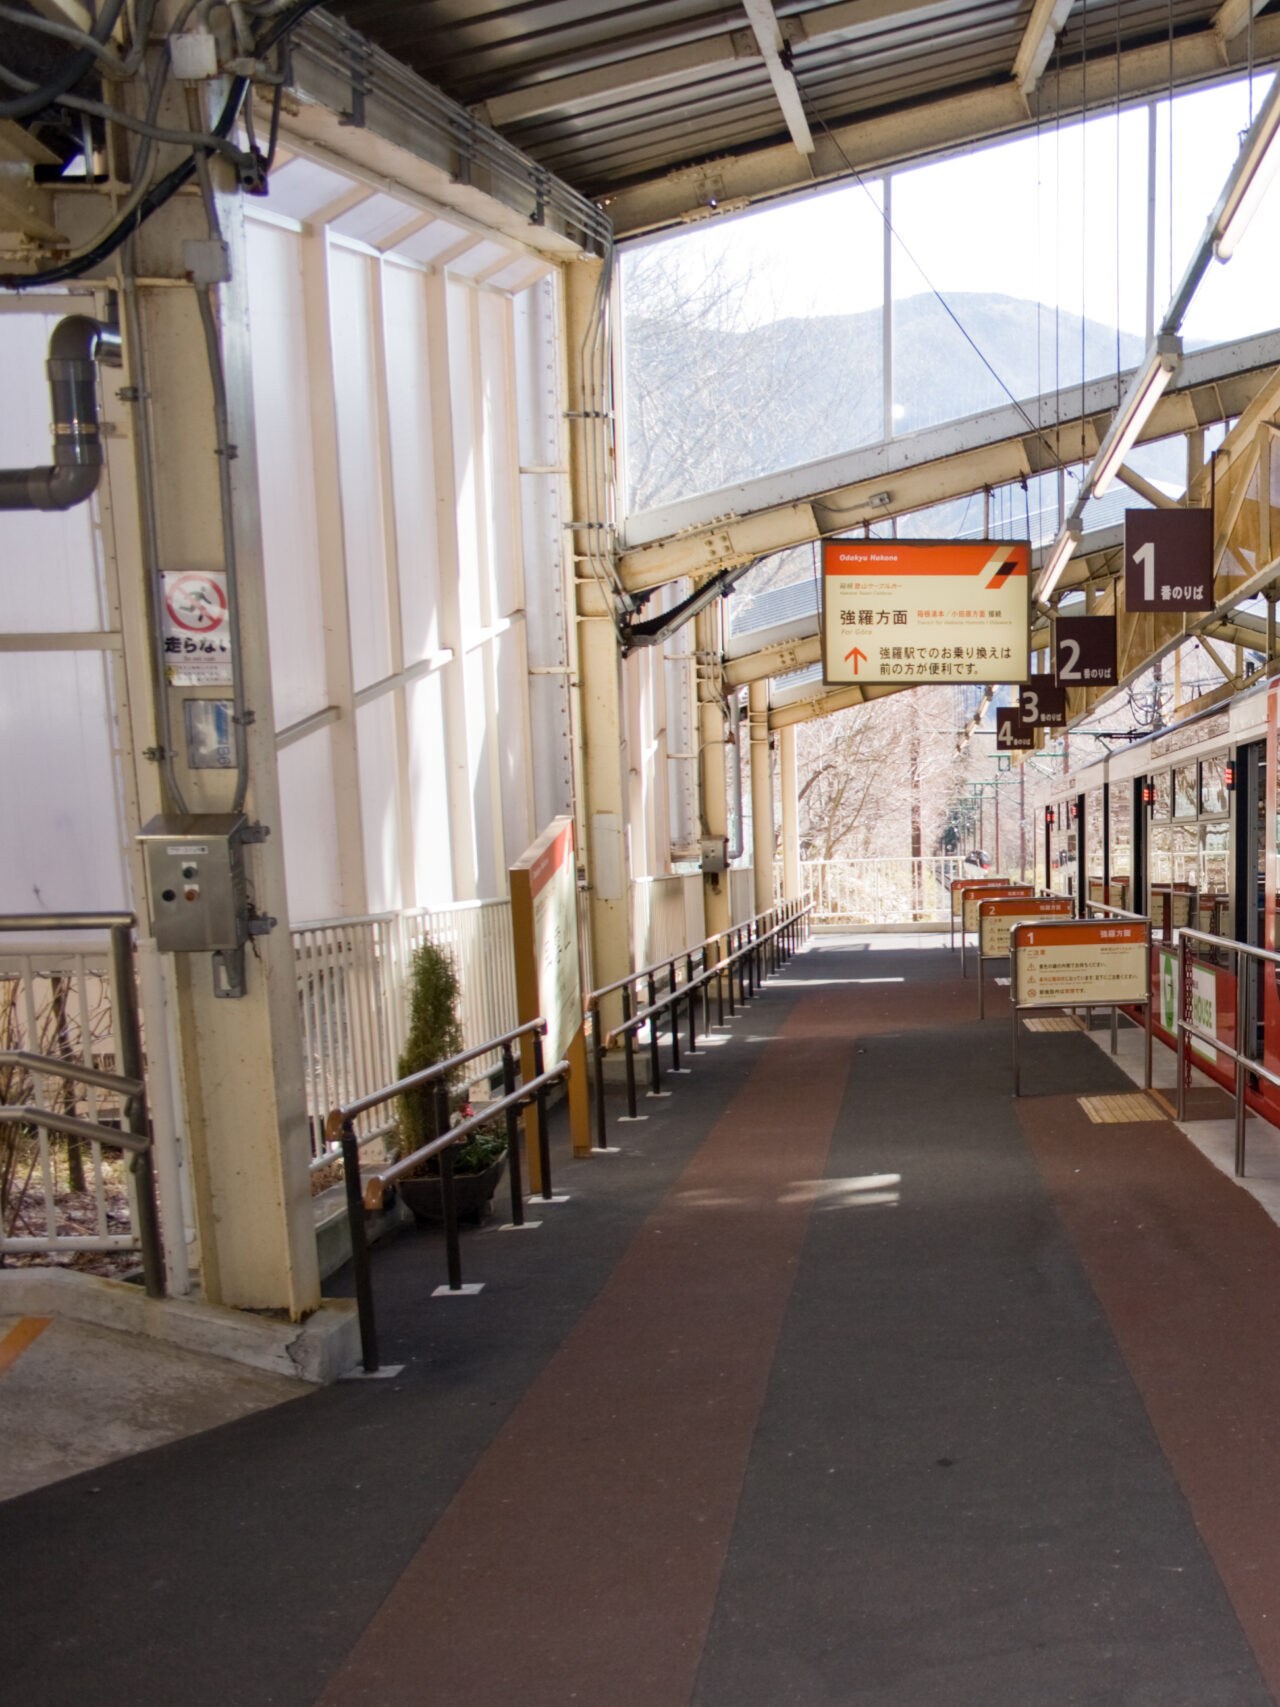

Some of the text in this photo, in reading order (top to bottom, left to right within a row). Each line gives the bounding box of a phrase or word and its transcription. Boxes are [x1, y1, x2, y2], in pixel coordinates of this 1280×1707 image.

[840, 554, 867, 562] Odakyu
[840, 610, 908, 625] 強羅方面
[880, 647, 1011, 660] 強羅駅でのお乗り換えは
[880, 663, 978, 675] 前の方が便利です。
[989, 906, 996, 915] 2
[1027, 932, 1034, 944] 1
